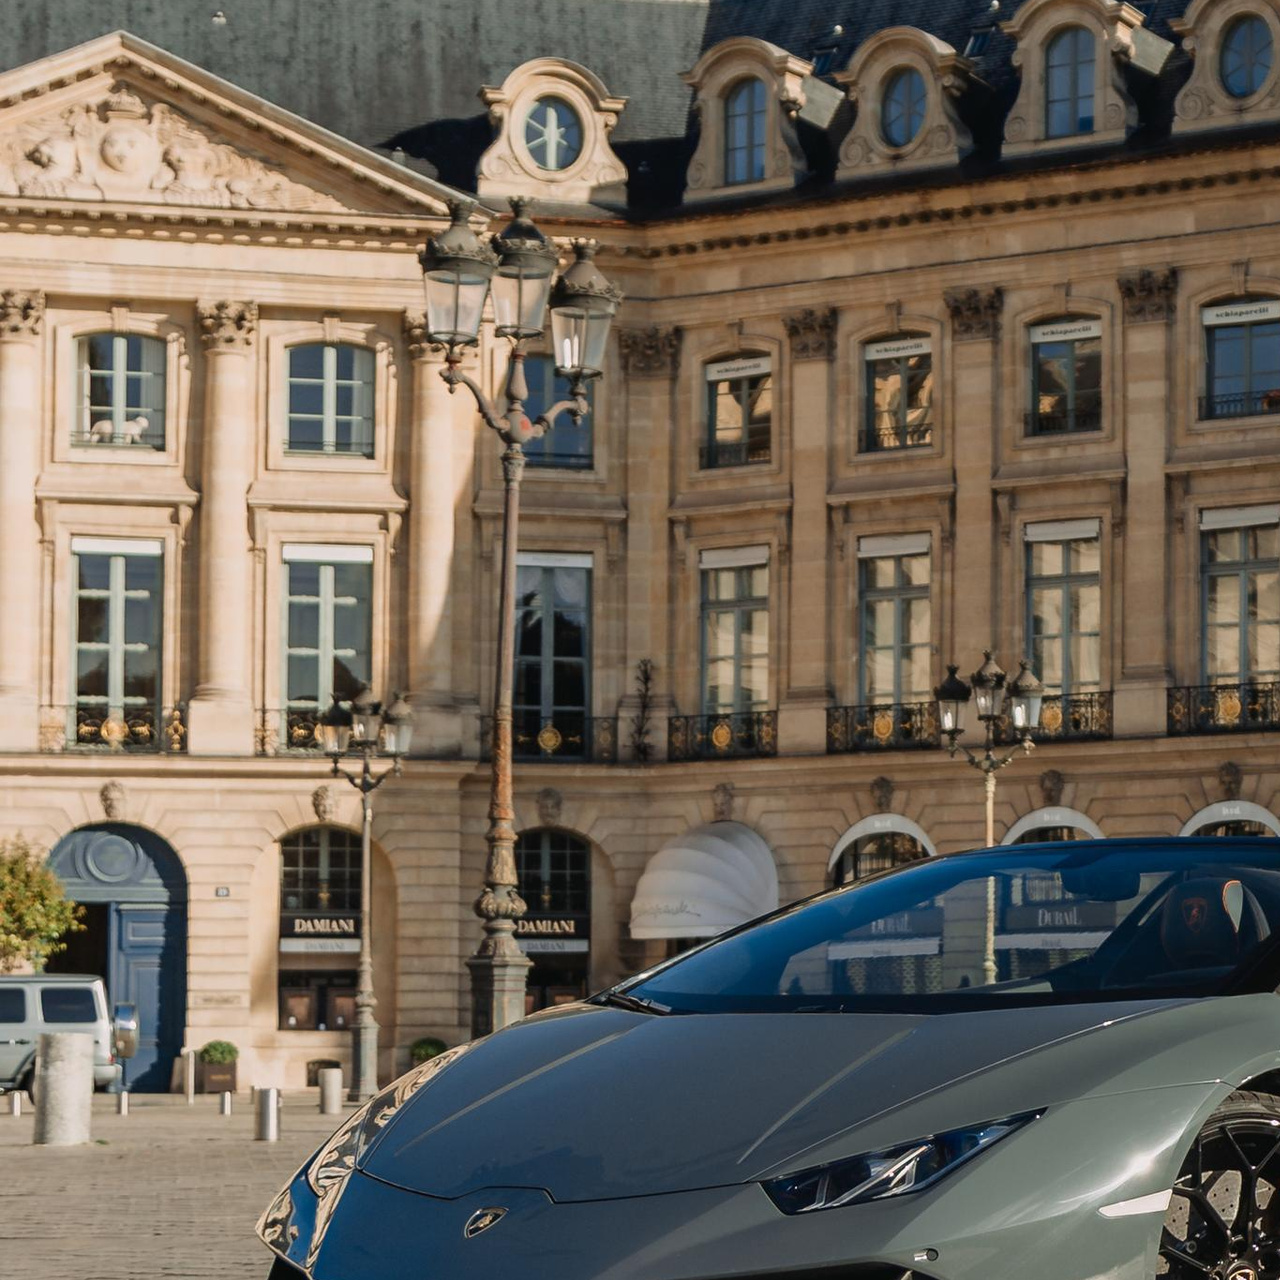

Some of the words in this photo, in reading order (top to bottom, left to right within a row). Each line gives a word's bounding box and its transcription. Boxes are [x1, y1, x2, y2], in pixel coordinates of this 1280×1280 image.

[1215, 307, 1269, 318] schiaparelli
[294, 919, 355, 933] DAMIANI
[518, 920, 575, 933] DAMIANI
